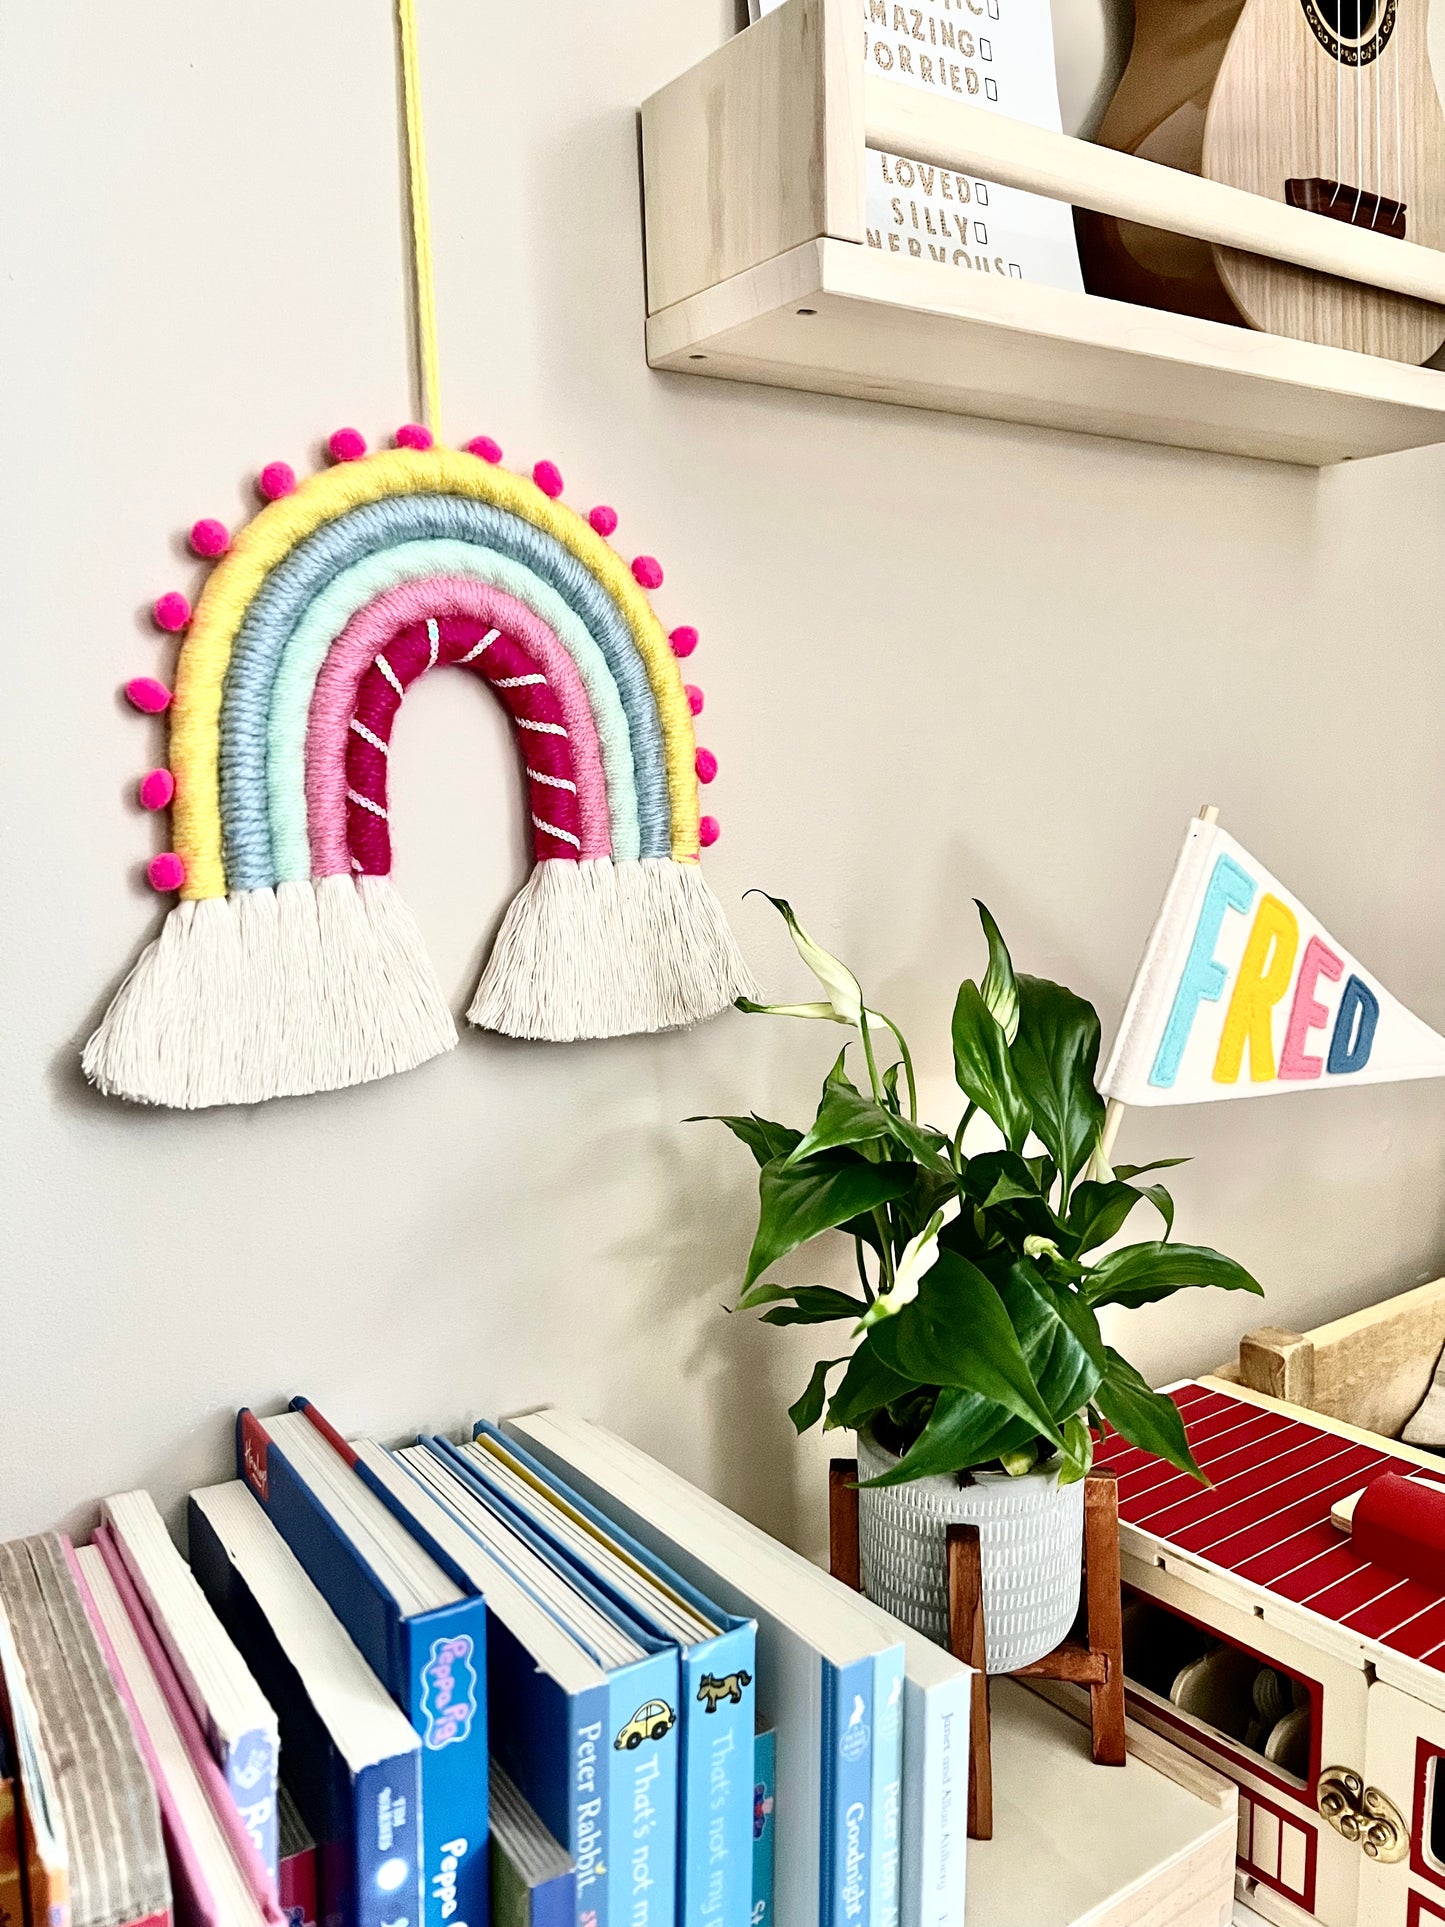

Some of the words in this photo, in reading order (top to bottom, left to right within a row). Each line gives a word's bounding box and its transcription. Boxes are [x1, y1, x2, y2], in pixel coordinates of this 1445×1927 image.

[864, 0, 976, 58] MAZING
[864, 31, 980, 95] ORRIED
[881, 154, 971, 204] LOVED
[890, 197, 968, 246] SILLY
[1148, 852, 1380, 1088] FRED
[578, 1720, 603, 1793] Peter
[940, 1711, 955, 1751] Janet
[632, 1752, 660, 1840] That's
[709, 1727, 735, 1810] That's
[941, 1757, 952, 1785] and
[708, 1816, 729, 1865] not
[842, 1801, 866, 1920] Goodnight
[432, 1837, 469, 1919] Peppa
[632, 1845, 654, 1896] not
[701, 1869, 724, 1915] my
